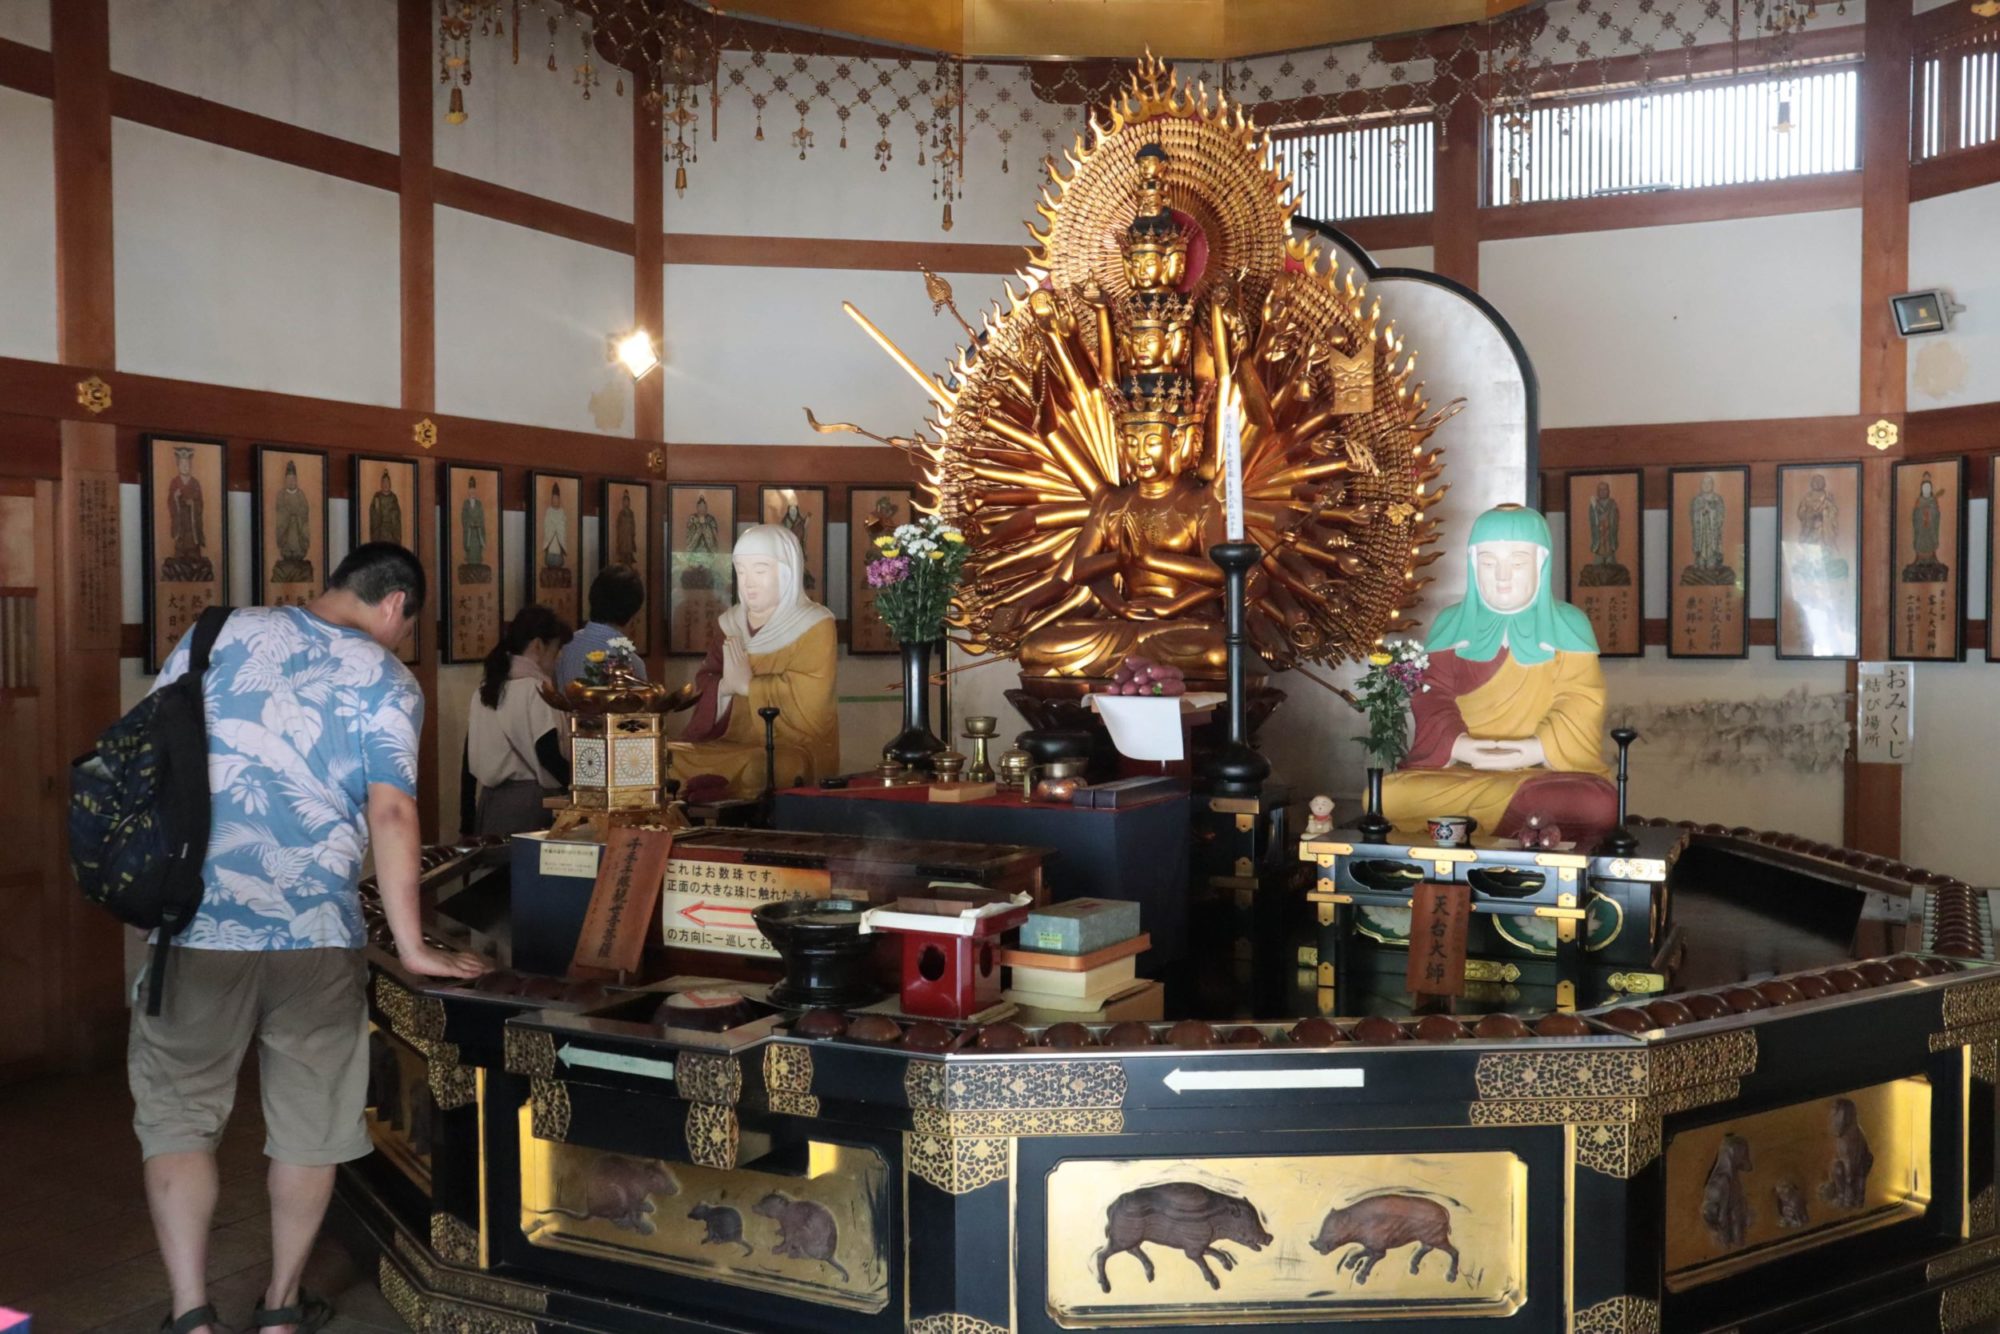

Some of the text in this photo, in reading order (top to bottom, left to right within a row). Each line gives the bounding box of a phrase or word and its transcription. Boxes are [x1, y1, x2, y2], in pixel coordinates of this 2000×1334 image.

[1863, 677, 1881, 749] 結び場所
[1885, 669, 1908, 760] おみくじ
[666, 862, 777, 885] これはお数珠です。
[666, 928, 777, 951] の方向に一巡してお
[1424, 895, 1450, 985] 天台大師
